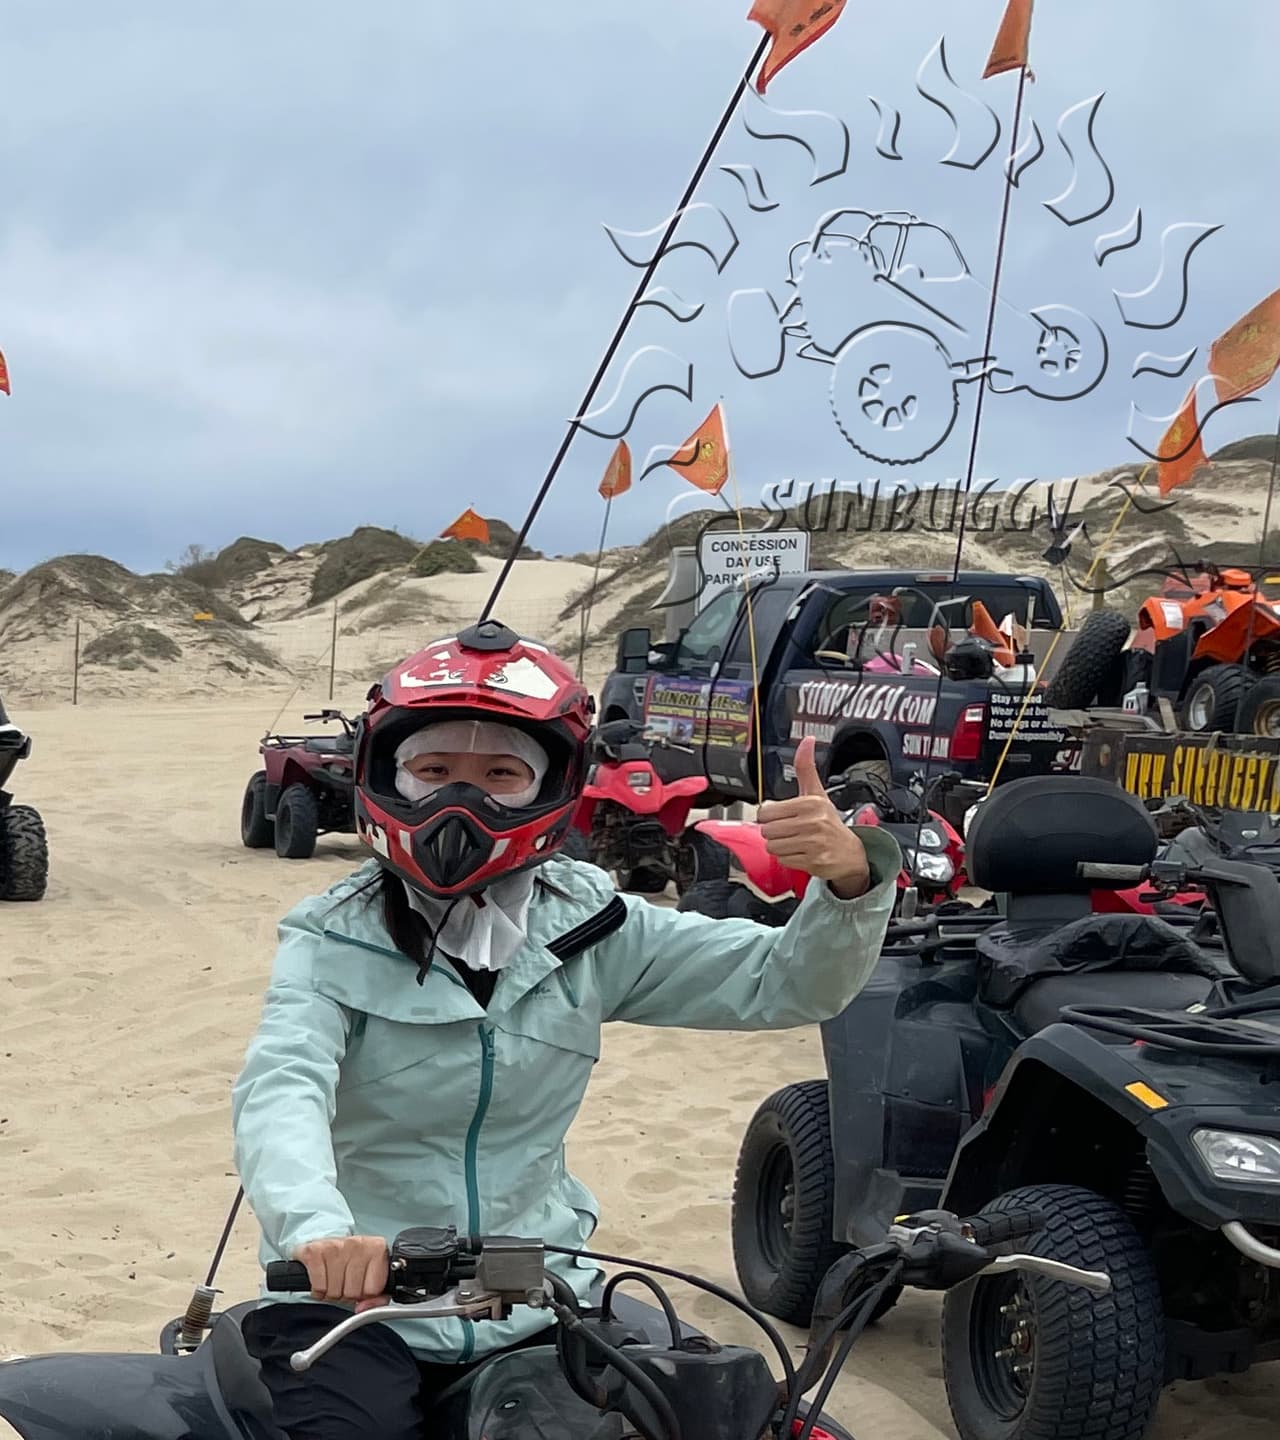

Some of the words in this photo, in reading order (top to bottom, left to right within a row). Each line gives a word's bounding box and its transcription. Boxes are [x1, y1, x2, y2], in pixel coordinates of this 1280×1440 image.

[711, 538, 798, 553] CONCESSION
[726, 557, 752, 568] DAY
[755, 555, 782, 567] USE
[991, 694, 1010, 704] Stay
[990, 719, 1003, 727] No
[1004, 718, 1029, 729] drgs
[902, 733, 921, 755] SUN
[922, 736, 950, 758] TAM
